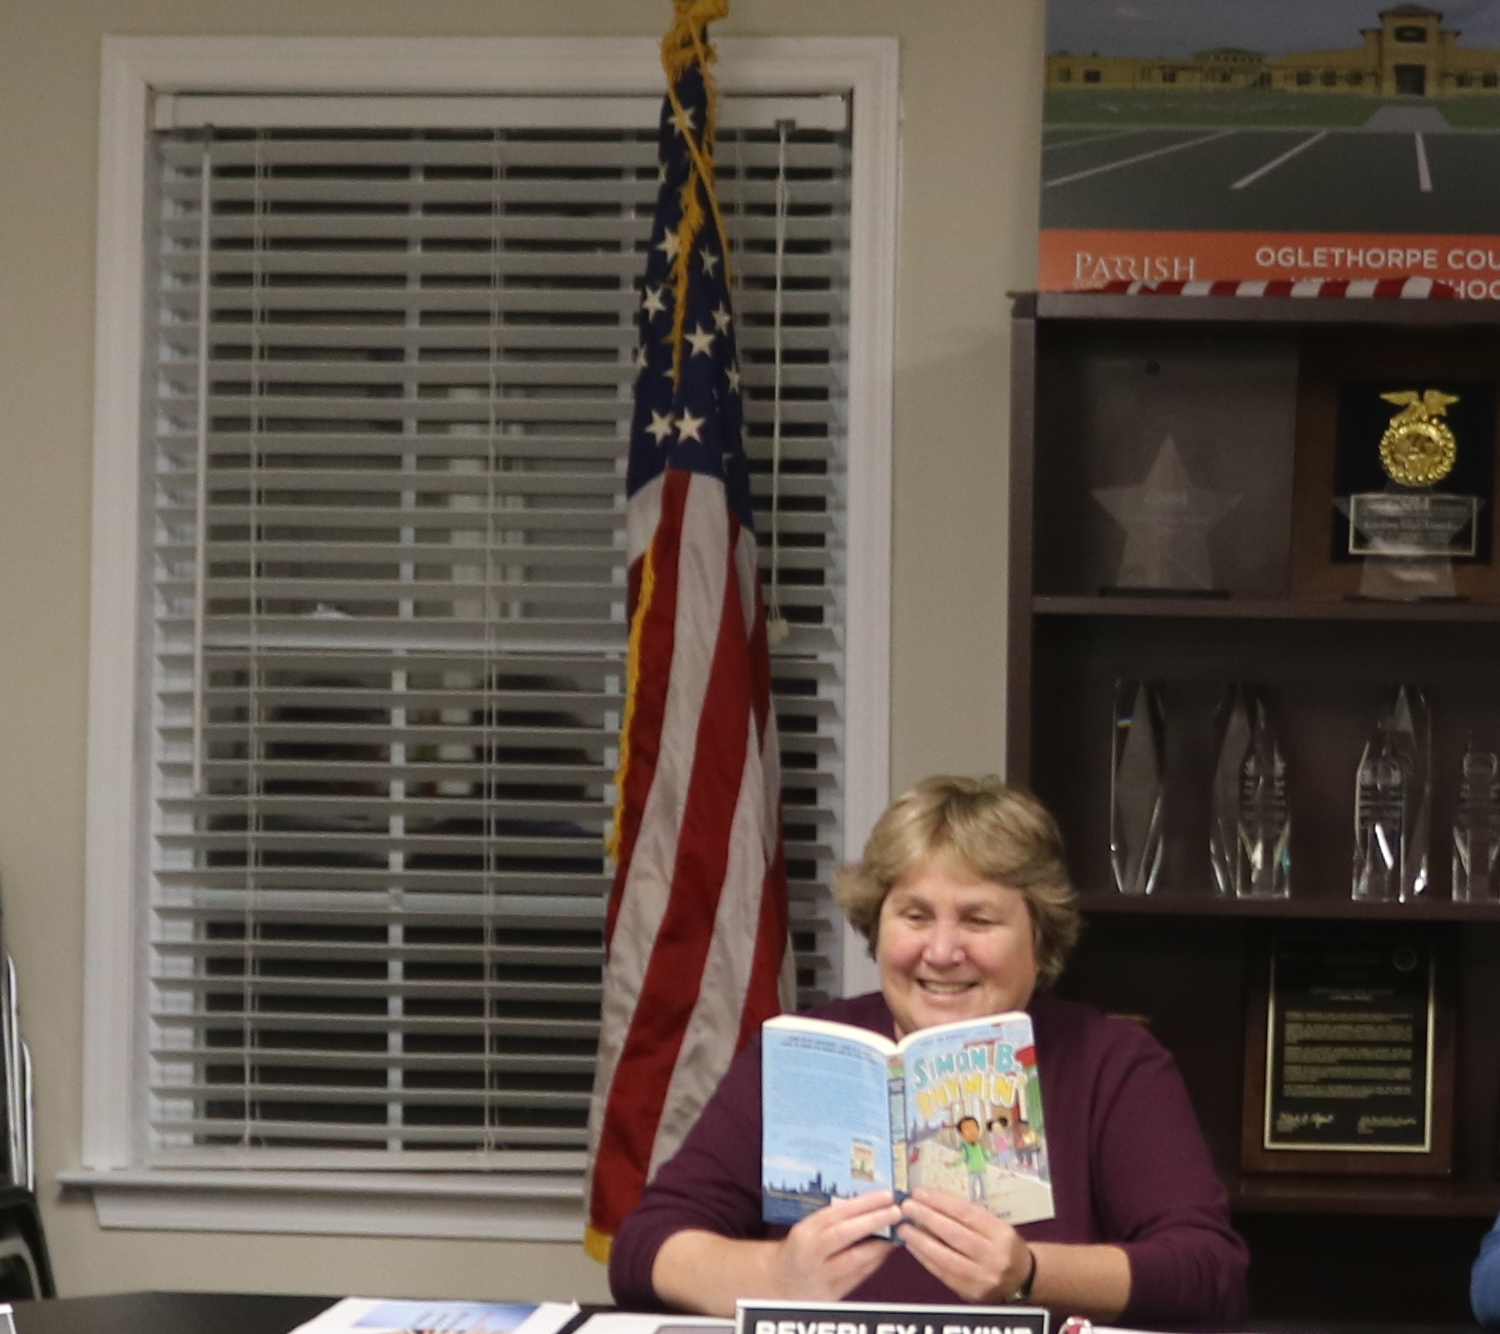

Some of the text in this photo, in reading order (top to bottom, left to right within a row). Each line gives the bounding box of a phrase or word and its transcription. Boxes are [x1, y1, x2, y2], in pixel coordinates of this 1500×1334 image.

[1075, 252, 1197, 281] PARRISH
[1255, 246, 1438, 271] OGLETHORPE
[913, 1047, 987, 1088] SIMON
